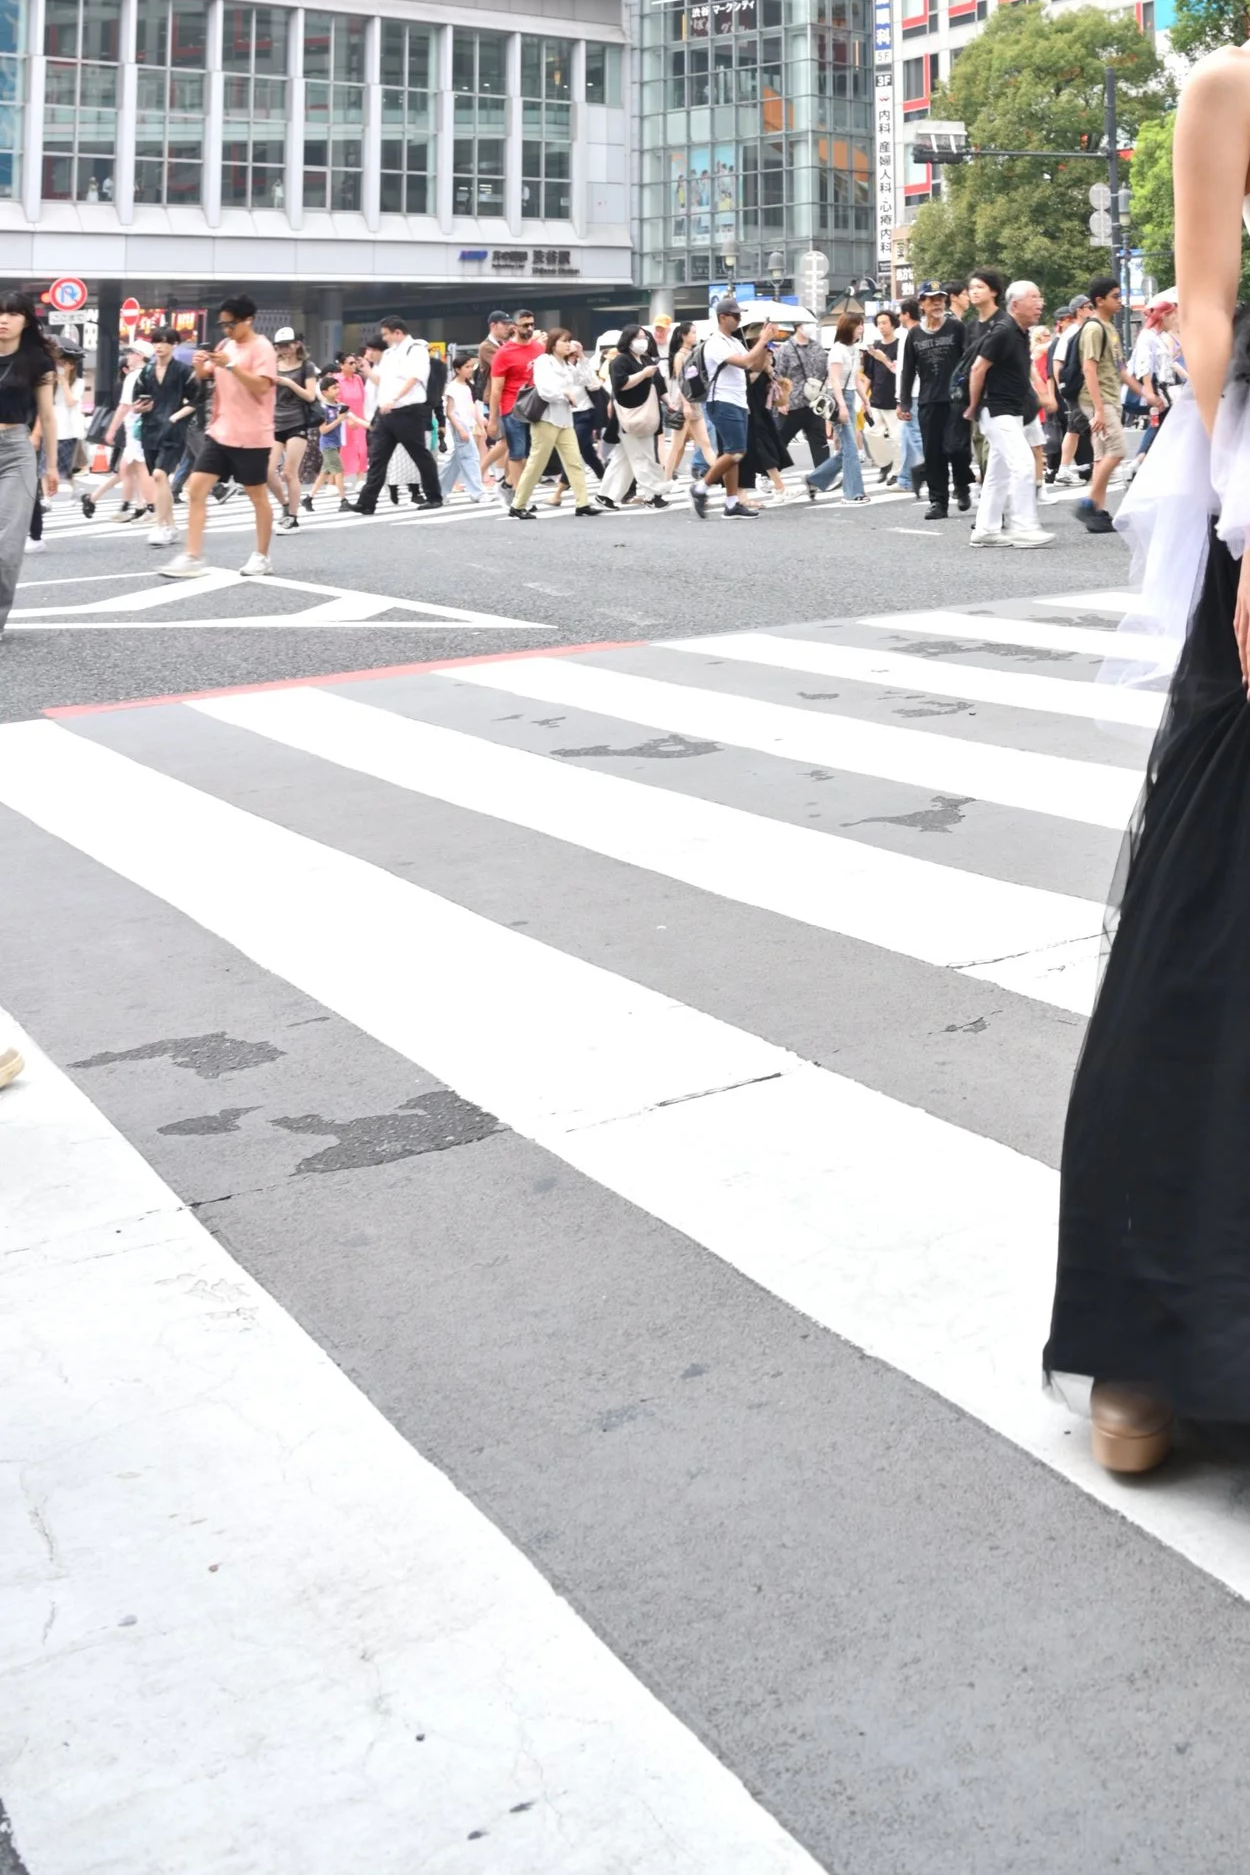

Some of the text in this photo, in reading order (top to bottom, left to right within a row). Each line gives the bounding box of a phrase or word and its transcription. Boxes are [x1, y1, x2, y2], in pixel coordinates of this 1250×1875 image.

[713, 0, 755, 14] マークシティ
[877, 75, 890, 86] 3F
[879, 110, 891, 134] 内科
